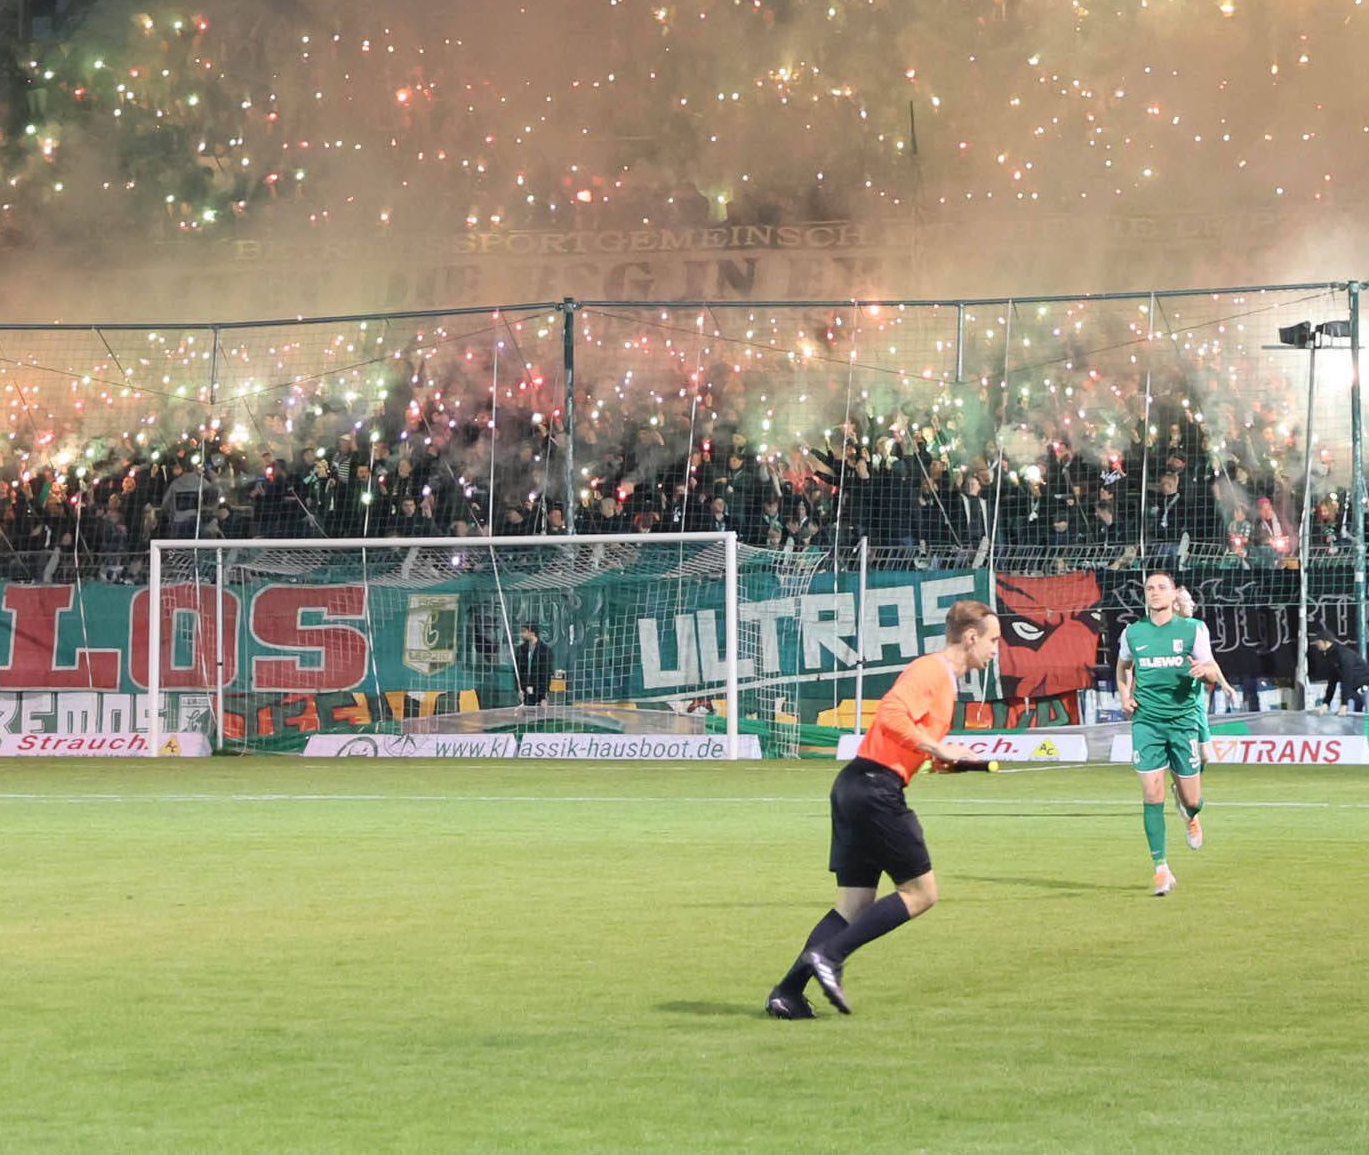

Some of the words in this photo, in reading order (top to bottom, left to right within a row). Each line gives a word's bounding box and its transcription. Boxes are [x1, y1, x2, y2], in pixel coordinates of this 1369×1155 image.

[637, 575, 976, 690] ULTRAS
[17, 733, 150, 751] Strauch.
[1240, 740, 1342, 763] TRANS
